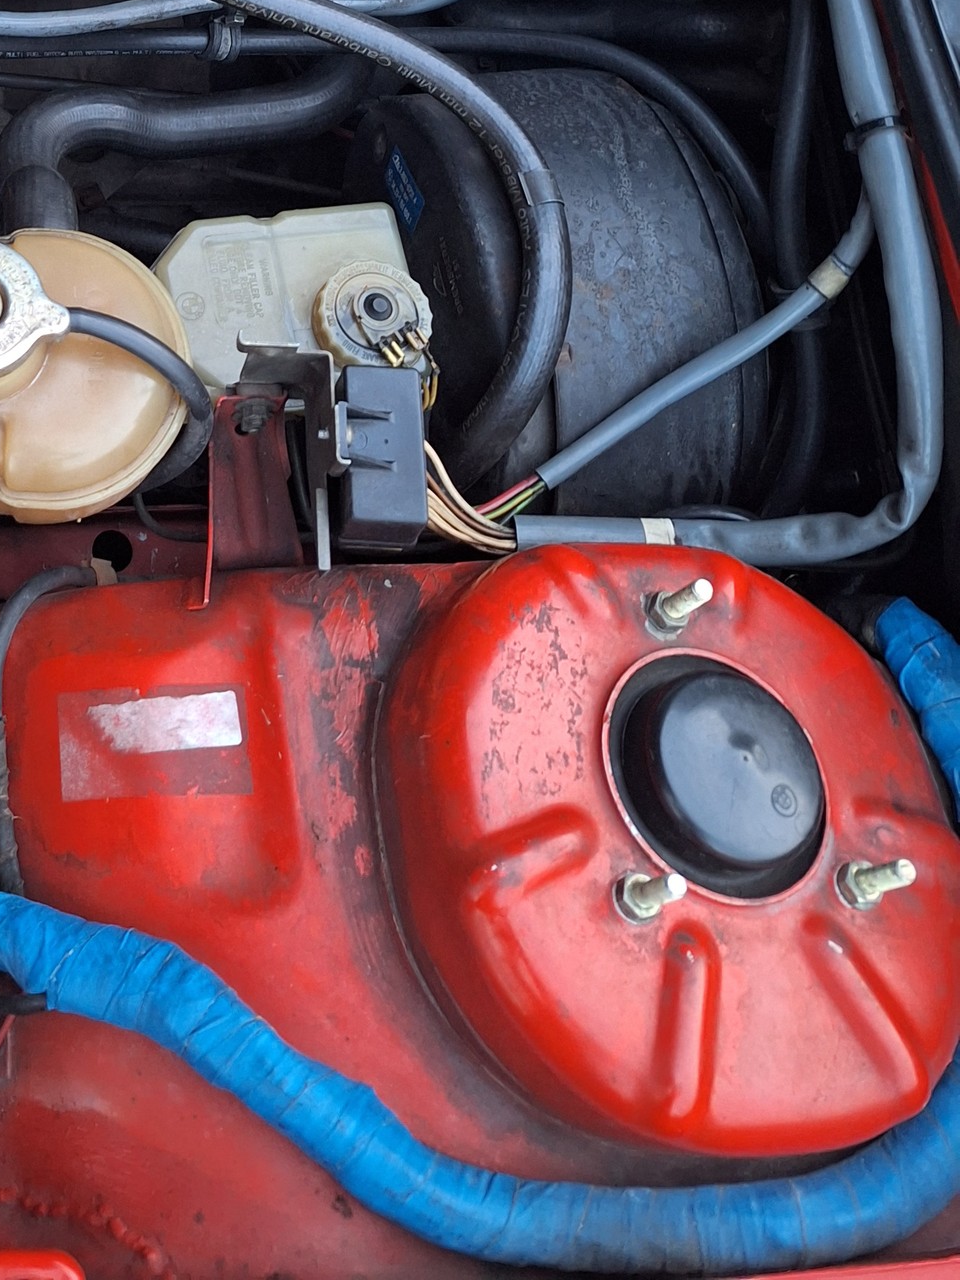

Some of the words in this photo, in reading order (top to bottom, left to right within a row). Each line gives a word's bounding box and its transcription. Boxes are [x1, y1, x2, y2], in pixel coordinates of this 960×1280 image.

[302, 23, 392, 68] Carburant
[397, 65, 437, 94] Multi
[440, 92, 468, 117] mm
[468, 118, 487, 139] 12
[489, 143, 522, 204] Master
[248, 272, 260, 300] FILLER
[253, 302, 264, 318] CAP
